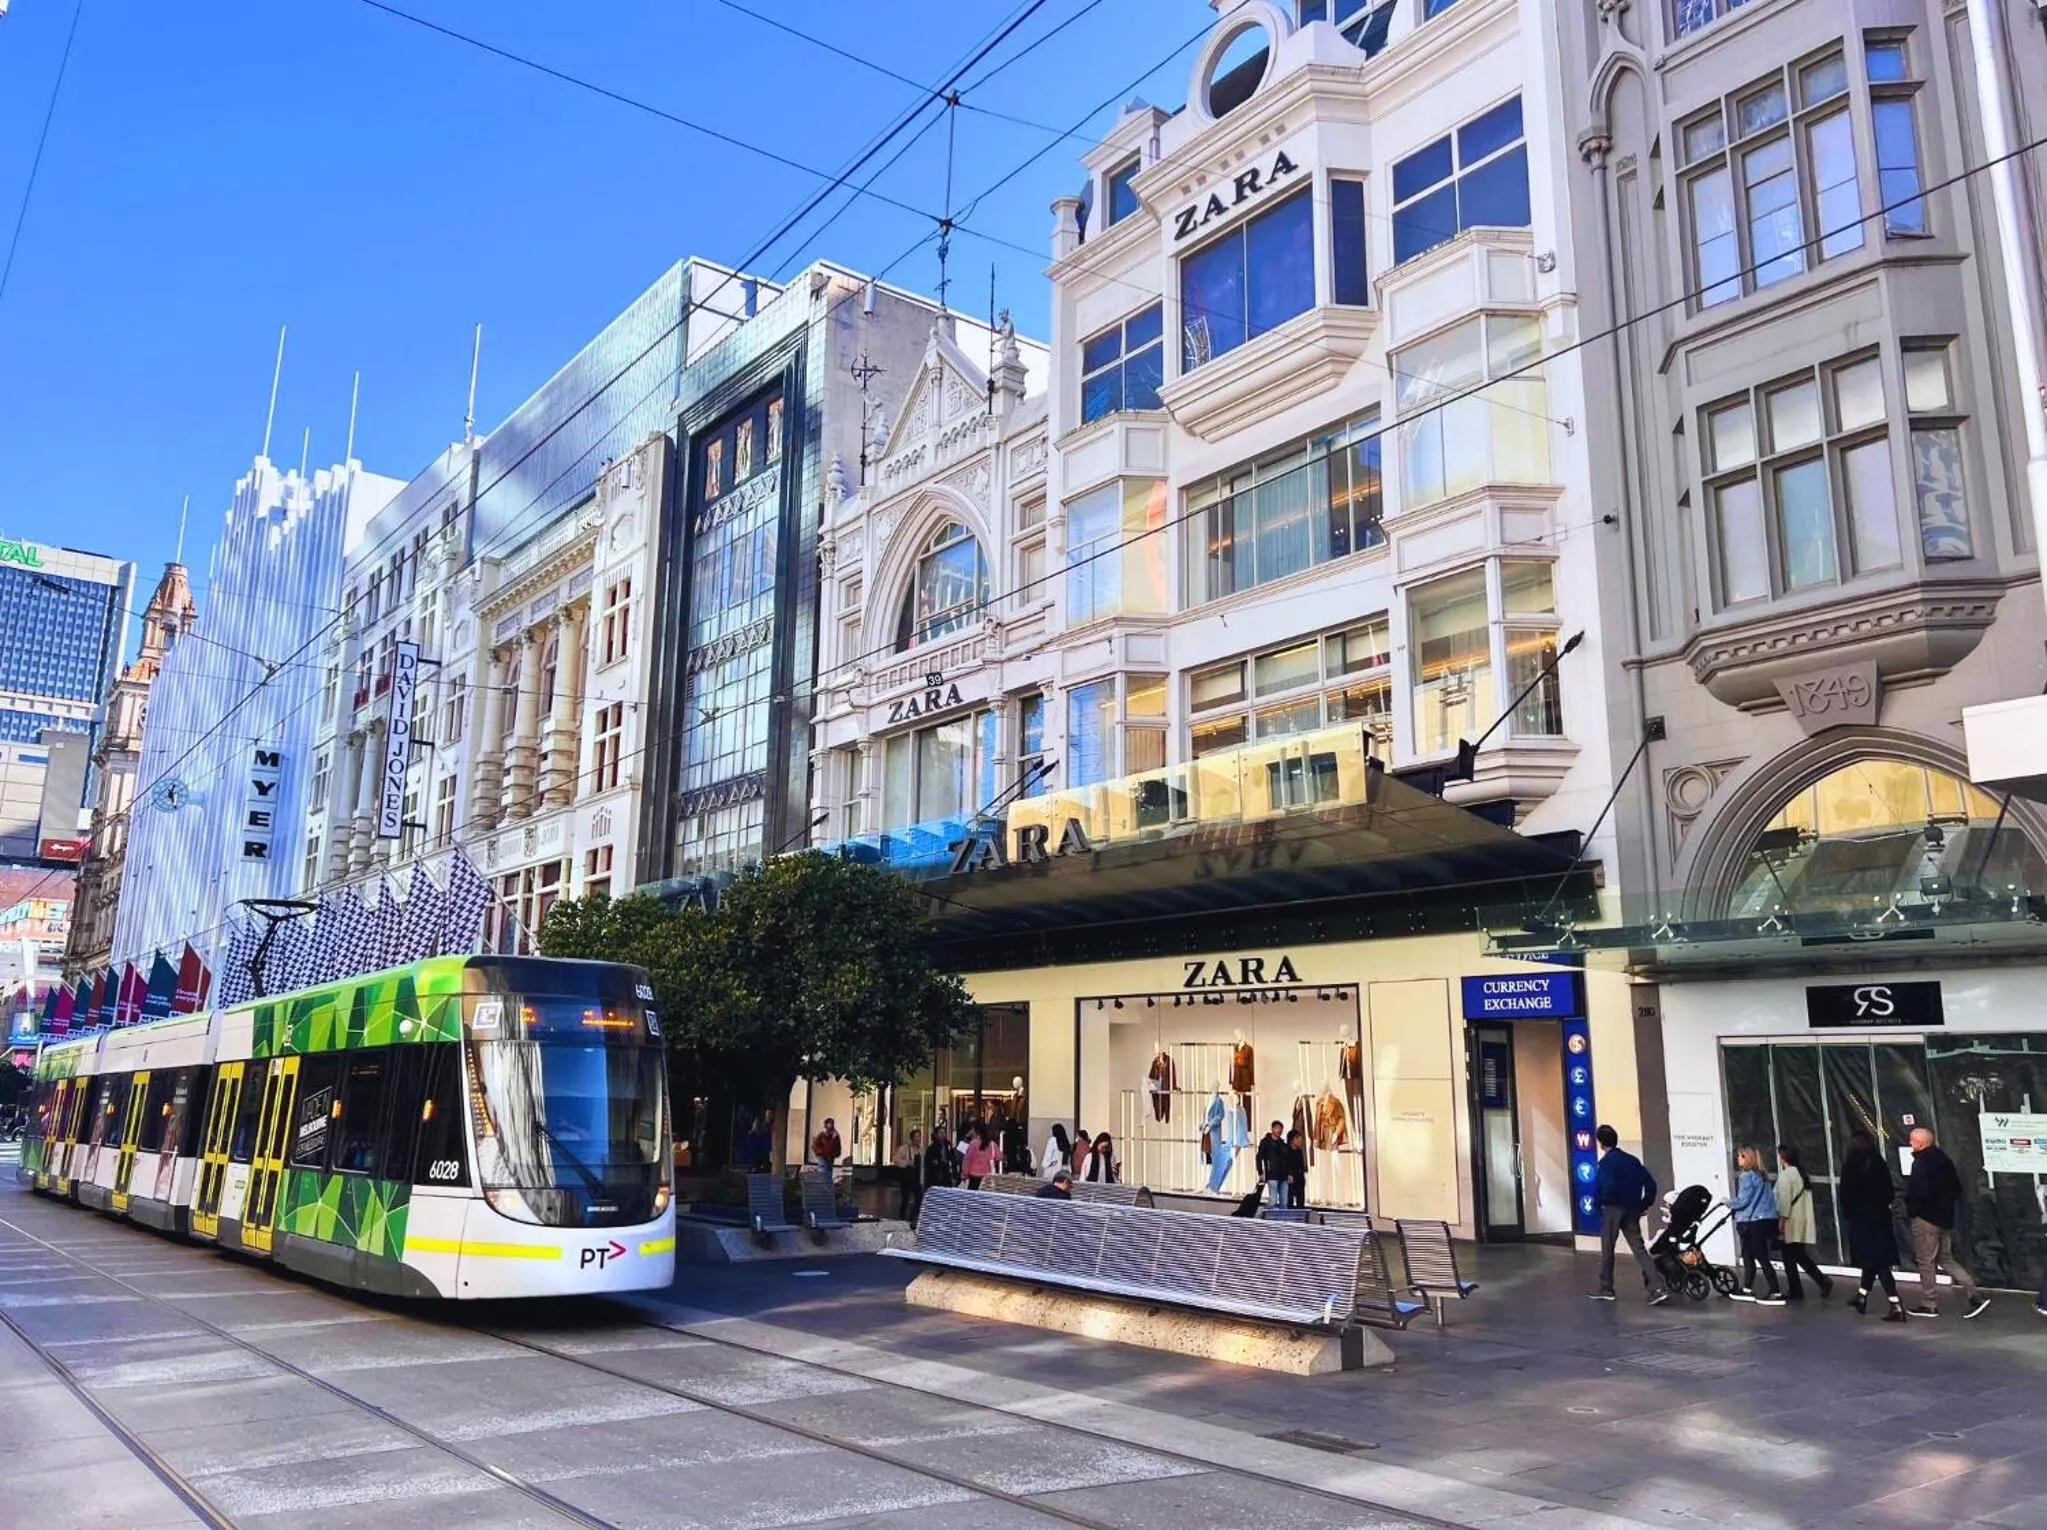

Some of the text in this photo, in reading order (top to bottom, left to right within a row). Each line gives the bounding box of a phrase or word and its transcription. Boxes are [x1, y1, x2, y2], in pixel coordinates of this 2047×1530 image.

[1174, 150, 1299, 241] ZARA
[928, 675, 941, 686] 39
[1790, 675, 1871, 717] 1849
[888, 683, 964, 724] ZARA
[384, 653, 415, 828] DAVID JONES
[244, 750, 280, 858] MYER
[948, 818, 1092, 873] ZARA
[1183, 955, 1303, 988] ZARA
[1483, 979, 1550, 993] CURRENCY
[1484, 997, 1552, 1011] EXCHANGE
[429, 1160, 459, 1180] 6028
[580, 1248, 611, 1269] PT
